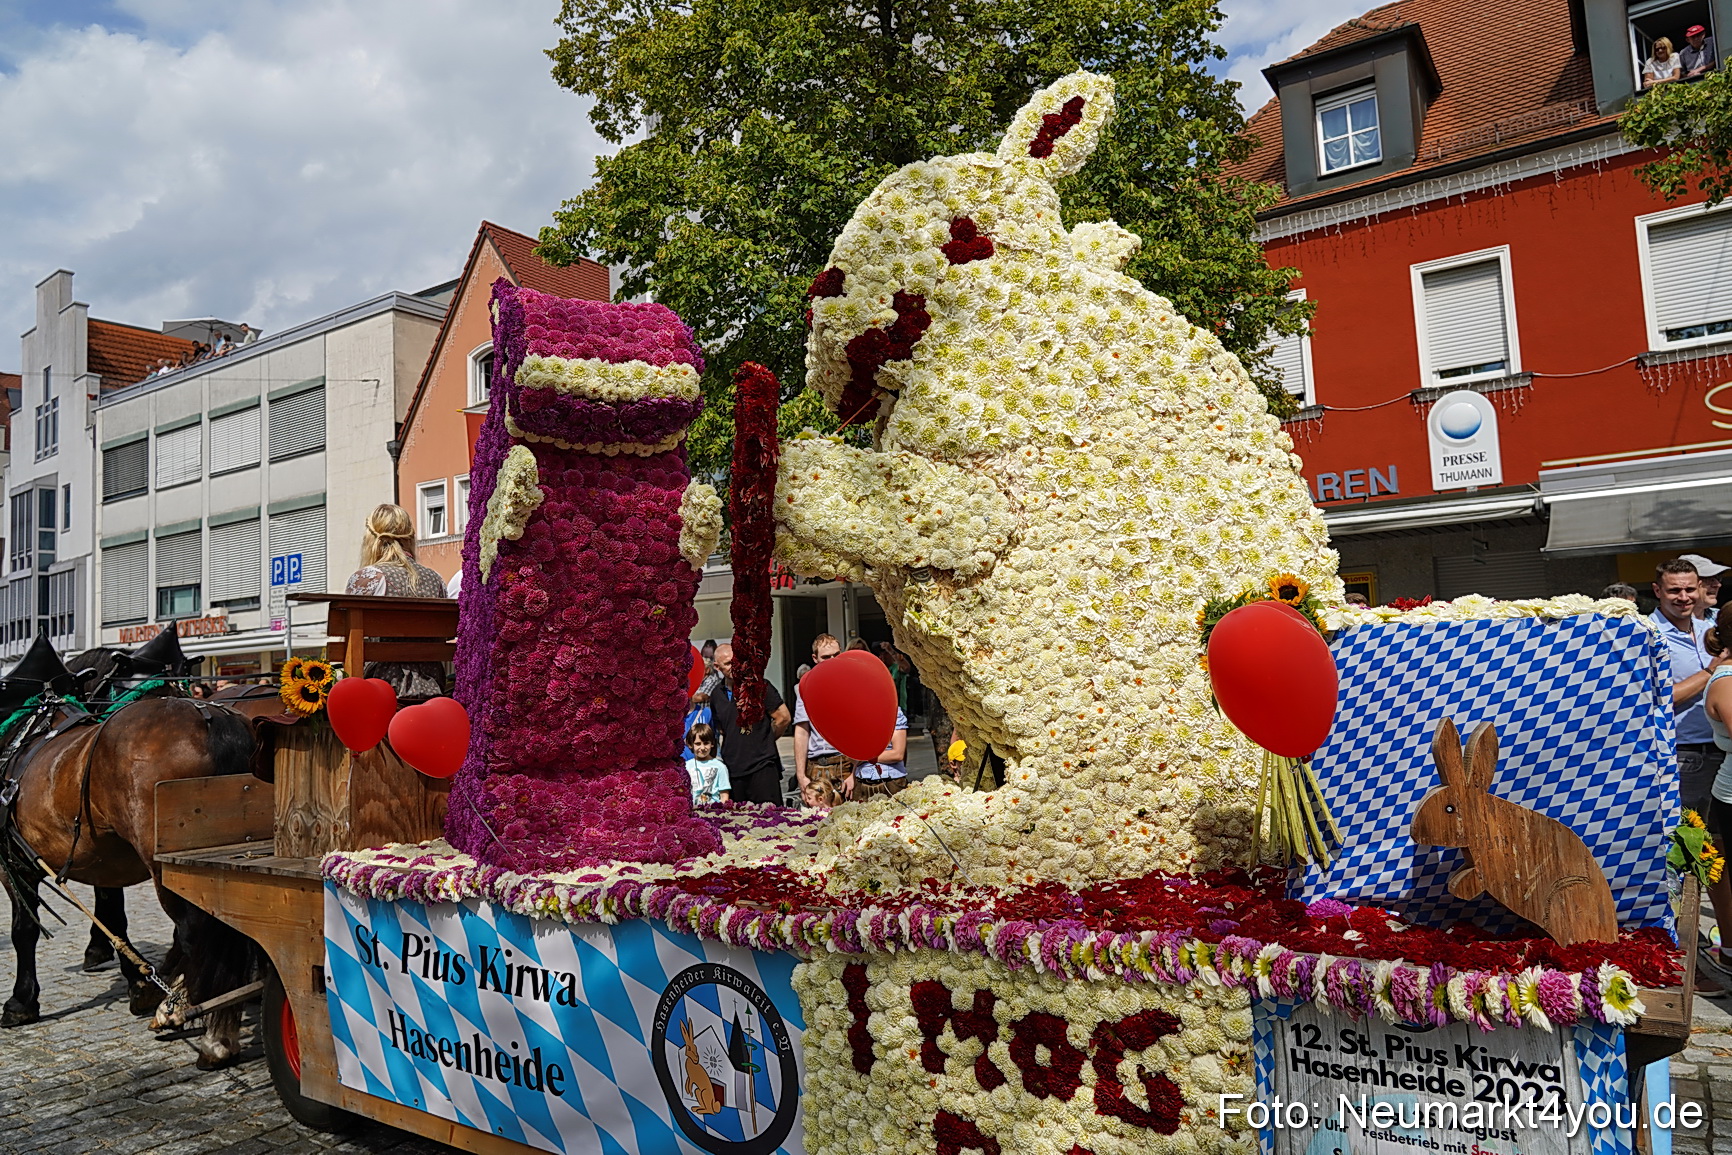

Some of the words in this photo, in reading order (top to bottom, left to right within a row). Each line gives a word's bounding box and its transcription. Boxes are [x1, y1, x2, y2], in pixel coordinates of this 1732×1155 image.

[1439, 467, 1492, 483] THUMANN
[1443, 451, 1487, 467] PRESSE
[1308, 465, 1399, 502] REN
[274, 560, 283, 583] P
[290, 557, 299, 581] P
[119, 615, 228, 643] MARIENOTHEKE
[355, 924, 389, 970] St.
[401, 932, 466, 985] Pius
[478, 945, 578, 1008] Kirwa
[655, 969, 706, 1033] Hasenheider
[713, 967, 770, 1014] Kirwaleit
[387, 1008, 566, 1097] Hasenheide
[1290, 1023, 1332, 1052] 12.
[1339, 1029, 1378, 1057] St.
[1385, 1034, 1448, 1066] Pius
[1455, 1044, 1561, 1083] Kirwa
[1290, 1048, 1465, 1098] Hasenheide
[1362, 1127, 1439, 1150] Festbetrieb
[1444, 1142, 1467, 1154] mit
